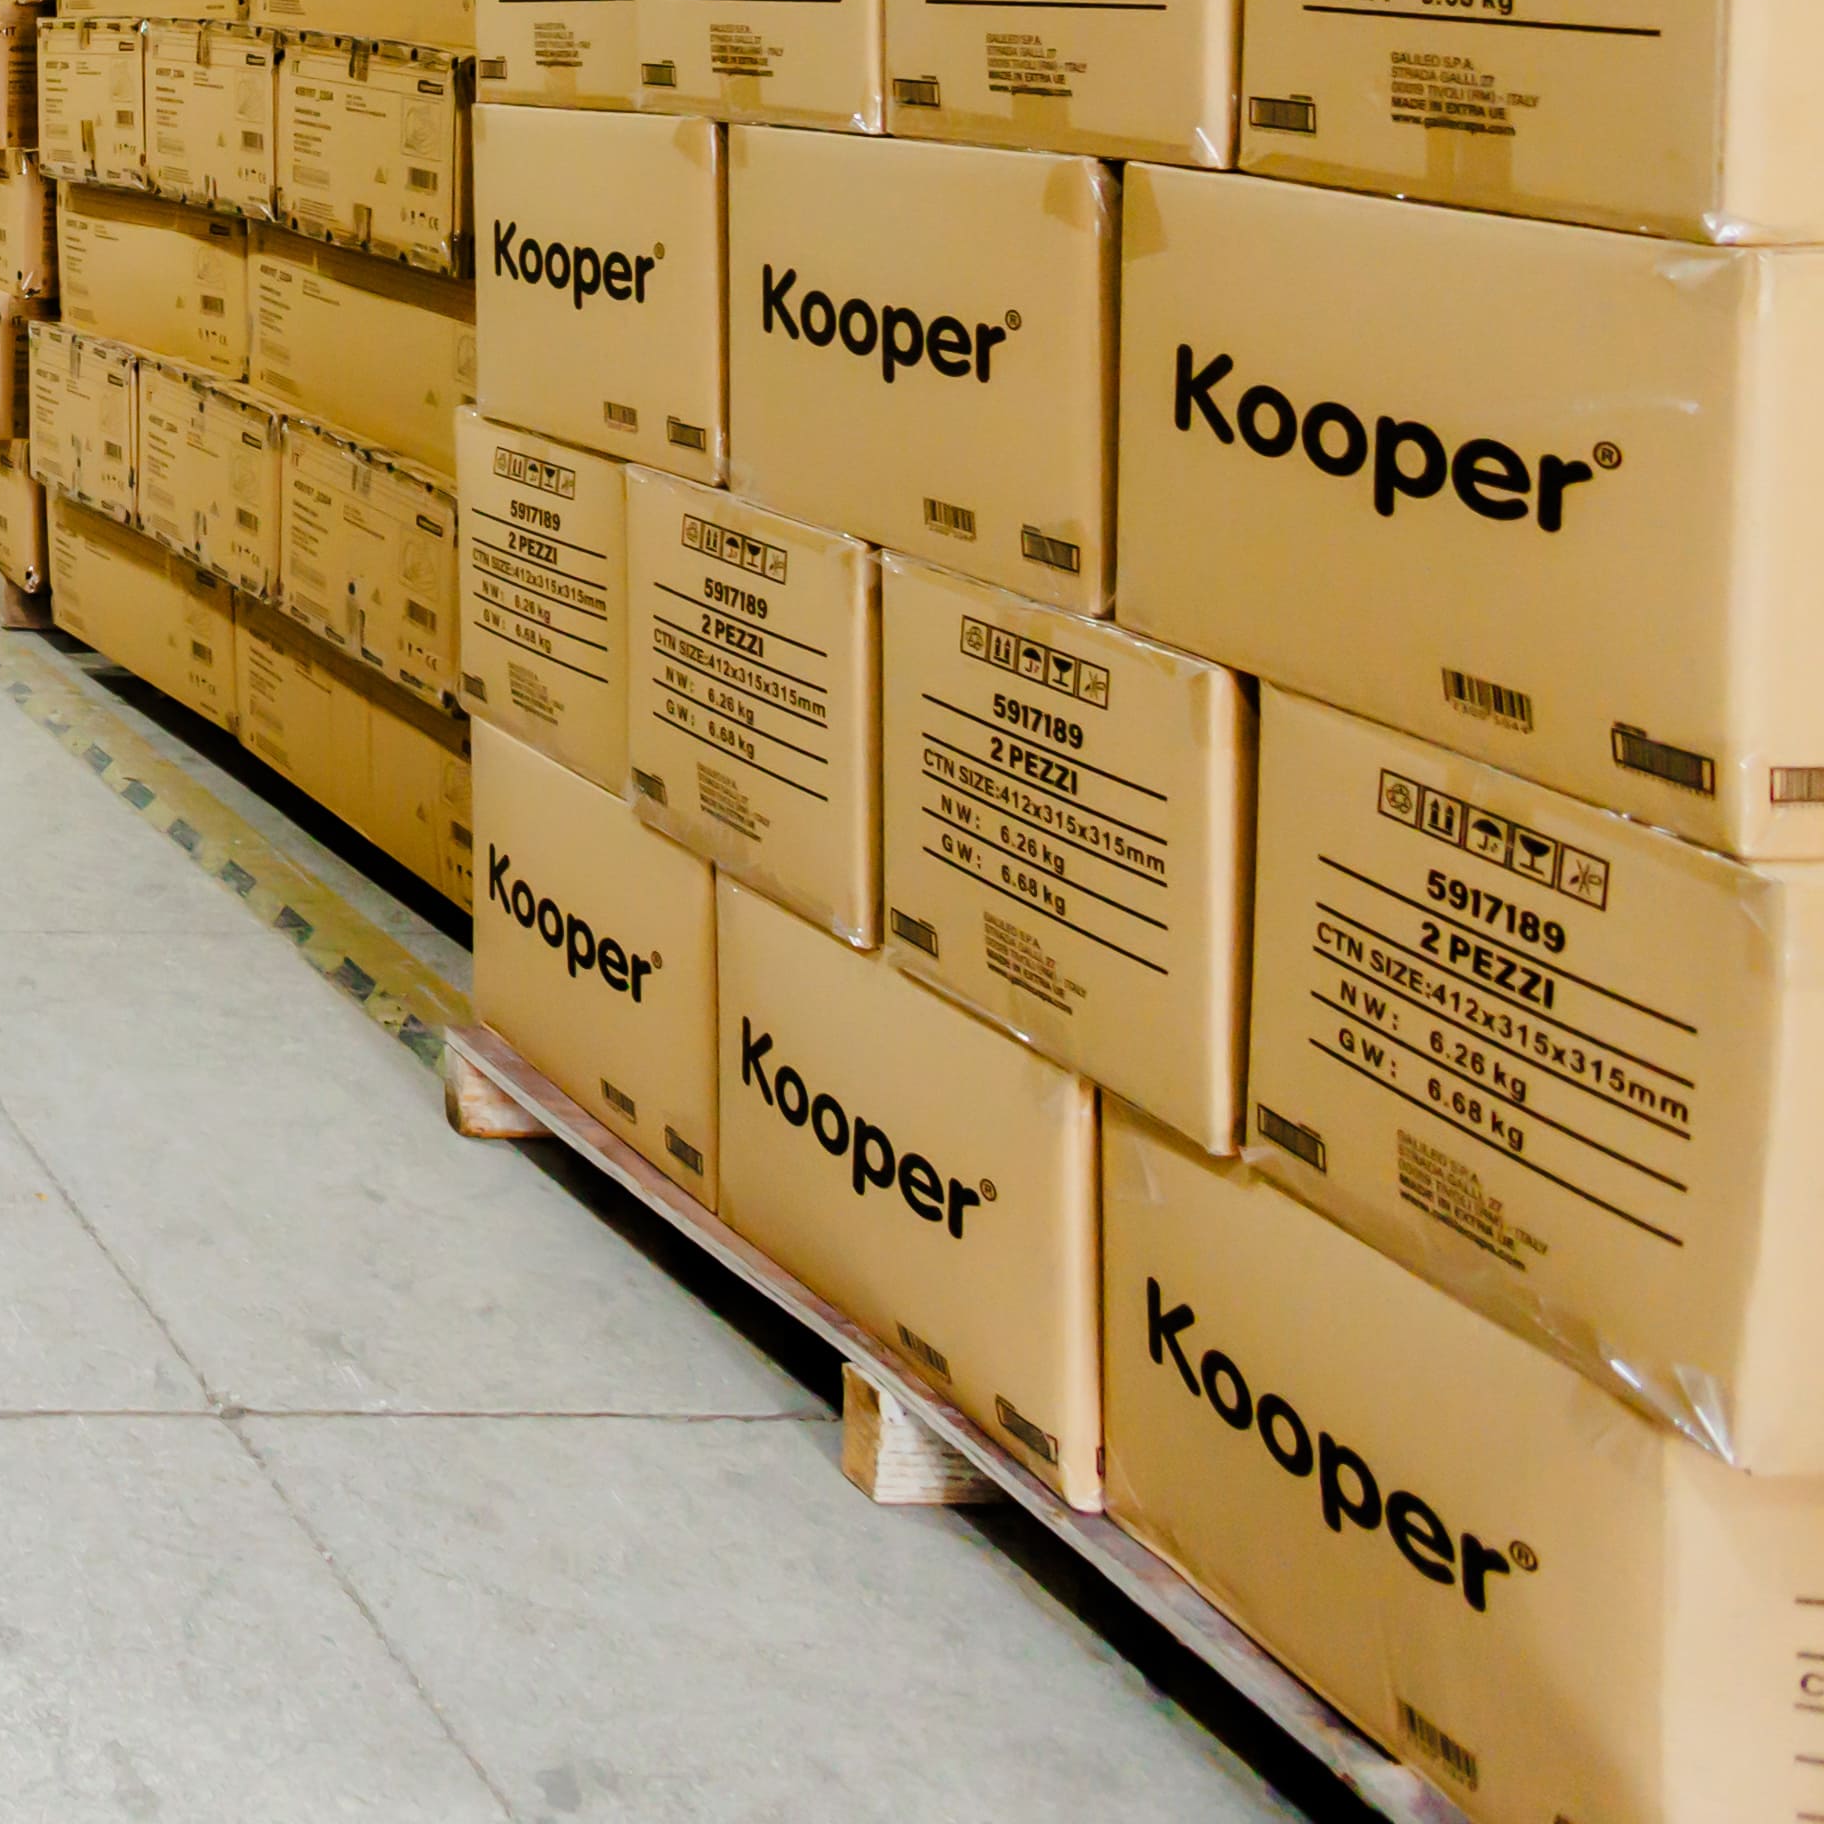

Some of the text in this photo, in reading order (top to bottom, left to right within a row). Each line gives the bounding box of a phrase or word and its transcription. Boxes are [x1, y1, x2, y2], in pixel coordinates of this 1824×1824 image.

[510, 500, 560, 532] 5917189
[520, 533, 557, 566] PEZZI
[703, 576, 767, 619] 5917189
[714, 618, 764, 659] PEZZI
[993, 693, 1083, 749] 5917189
[990, 737, 1078, 795] 2 PEZZI
[1427, 868, 1566, 955] 5917189
[1316, 921, 1364, 966] CTN
[1421, 921, 1556, 1009] 2 PEZZI
